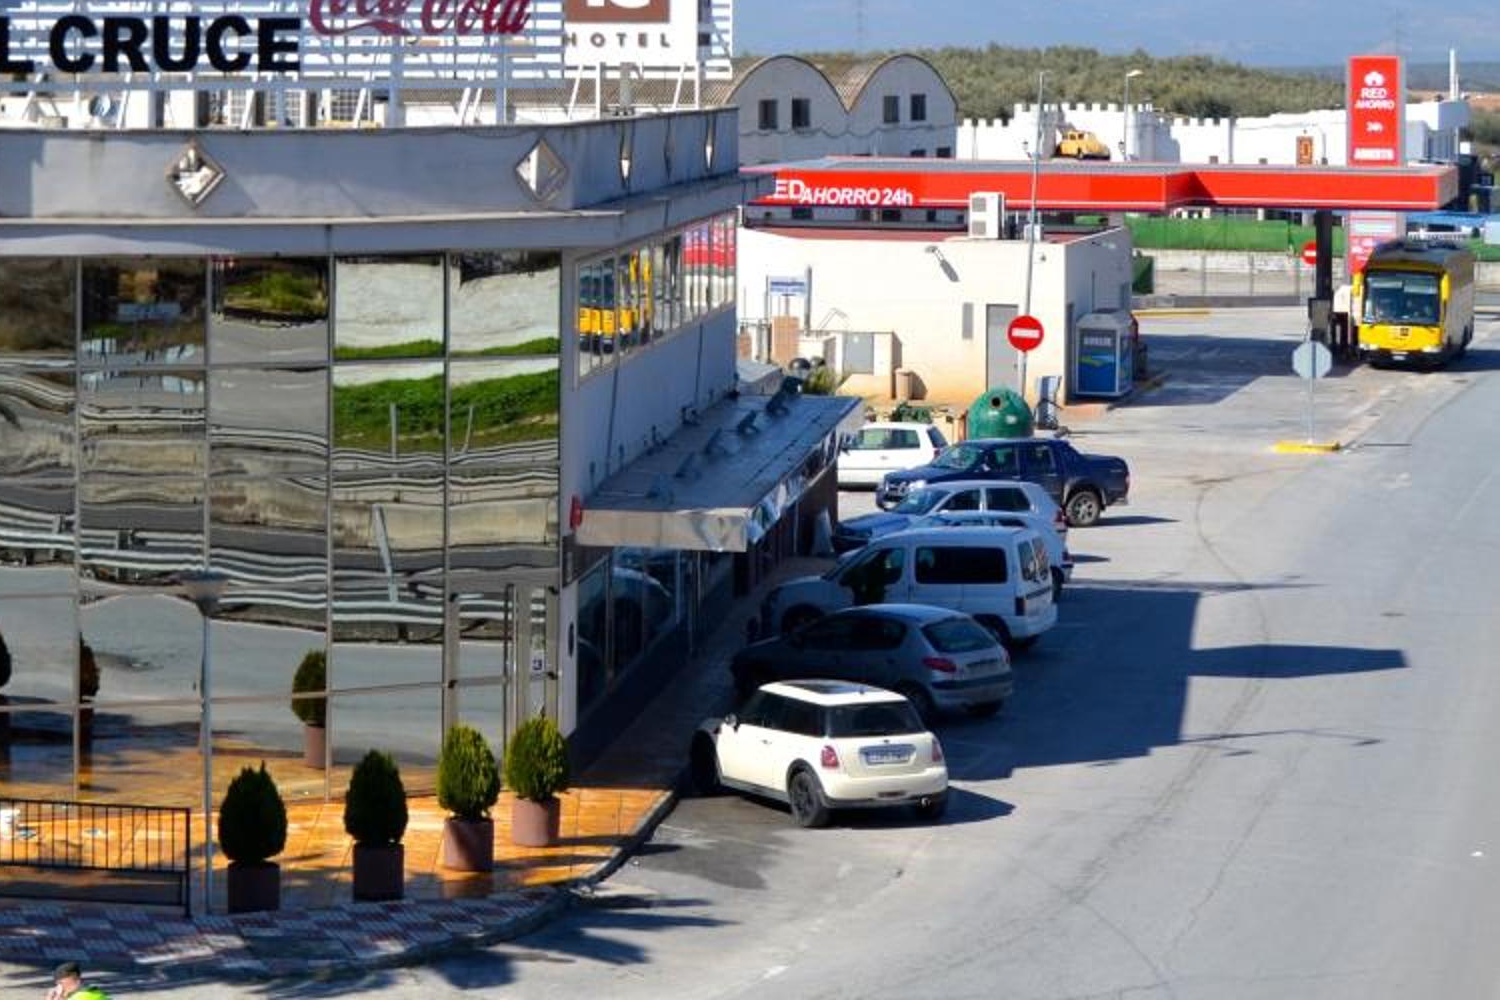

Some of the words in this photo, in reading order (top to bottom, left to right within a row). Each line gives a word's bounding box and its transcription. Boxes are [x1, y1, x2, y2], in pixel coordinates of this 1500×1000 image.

[50, 15, 301, 73] CRUCE
[564, 32, 671, 47] HOTEL
[1360, 87, 1387, 99] RED
[1354, 99, 1395, 110] AHORRO
[770, 178, 805, 200] ED
[800, 187, 881, 205] AHORRO
[882, 188, 914, 206] 24h
